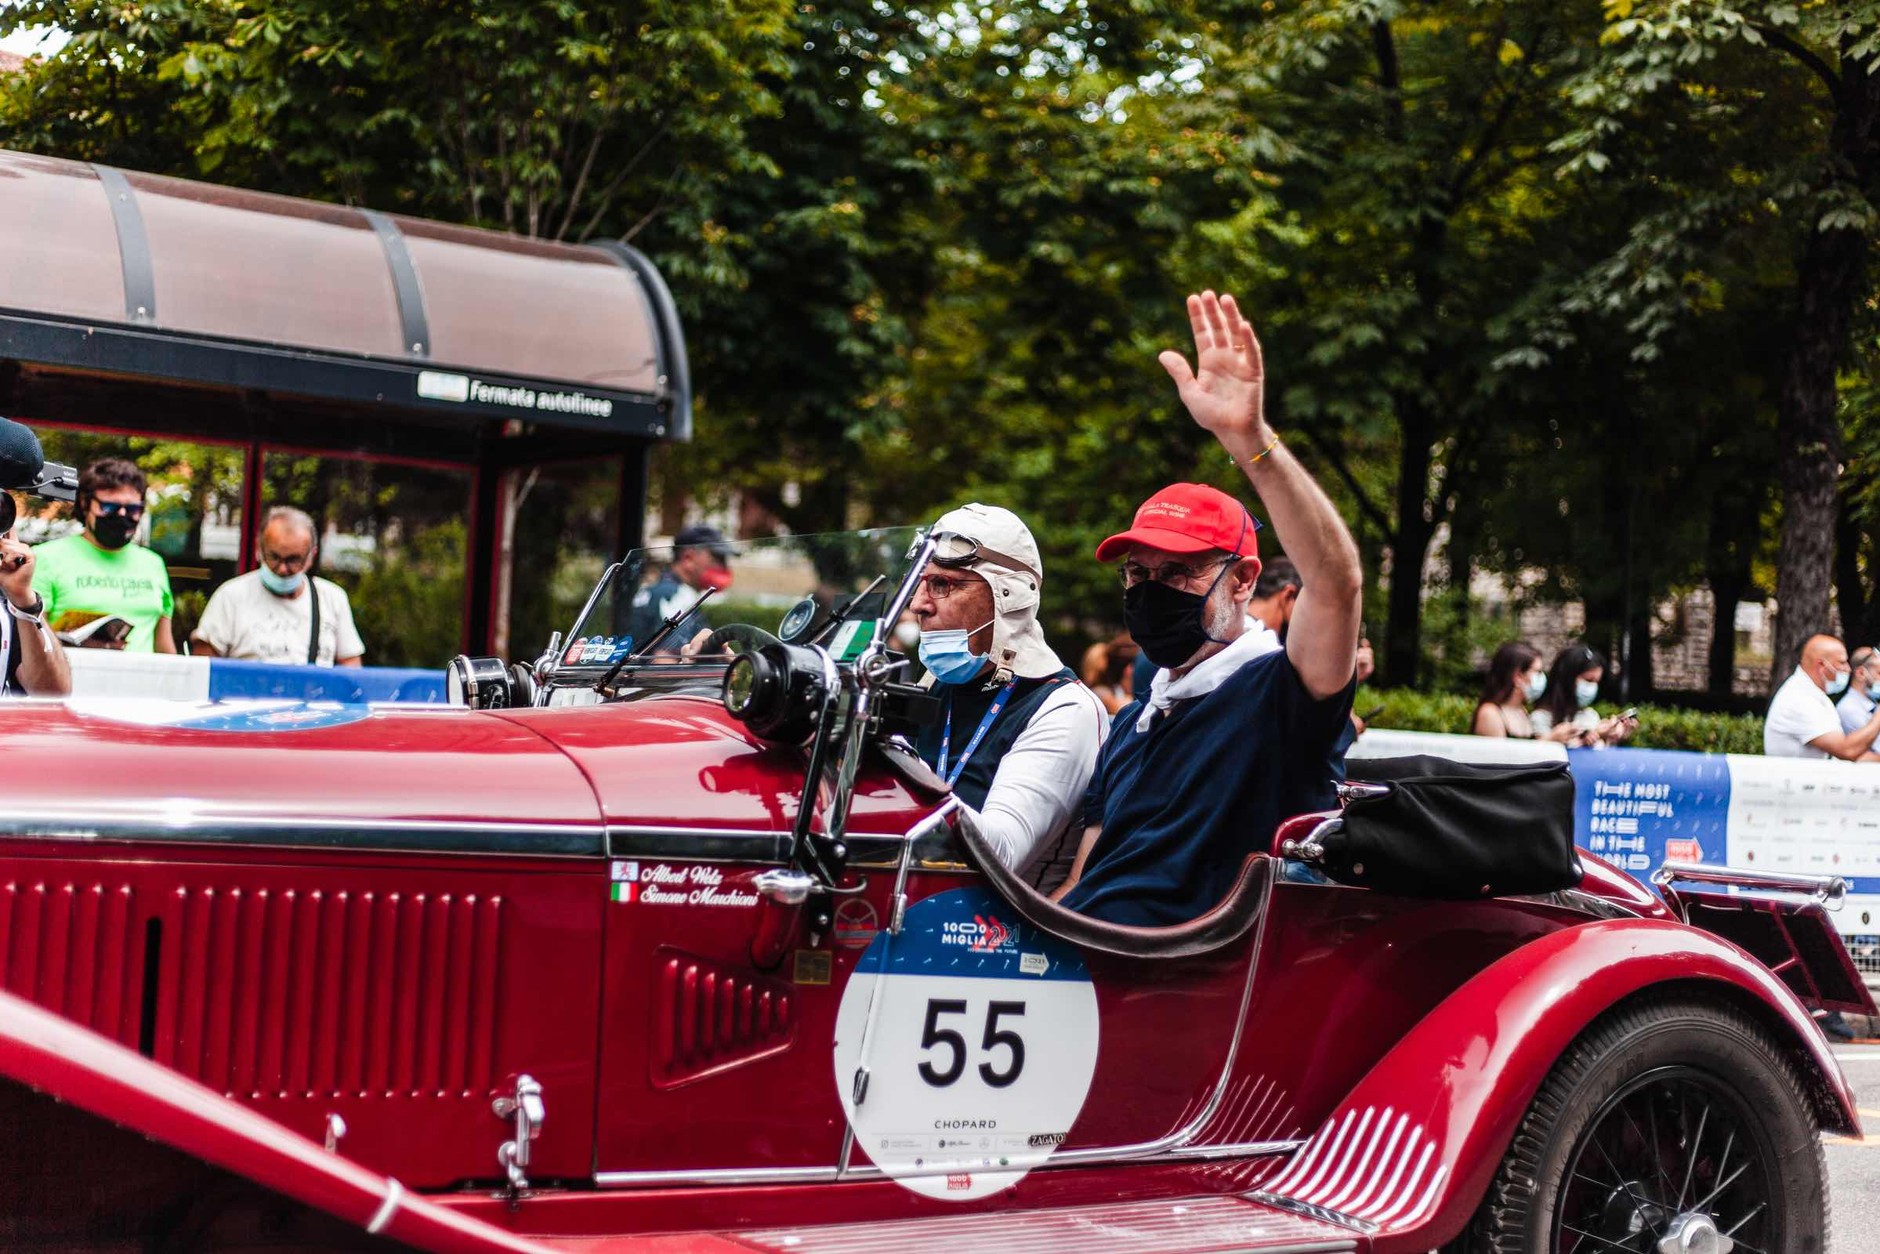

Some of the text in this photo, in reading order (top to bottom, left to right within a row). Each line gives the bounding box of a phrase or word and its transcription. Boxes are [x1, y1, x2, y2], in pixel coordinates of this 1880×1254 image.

[470, 380, 613, 417] Fermata autolinee
[1595, 780, 1671, 800] THE MOST
[1591, 798, 1675, 818] BEAUTIFUL
[1590, 816, 1639, 834] RACE
[1589, 835, 1645, 852] IN THE
[641, 864, 689, 884] Albert
[640, 885, 760, 907] Simone Marchioni
[942, 922, 987, 934] 1000
[941, 934, 987, 946] MIGLIA
[918, 998, 1026, 1088] 55
[934, 1120, 997, 1130] CHOPARD
[1031, 1134, 1065, 1146] ZAGATO
